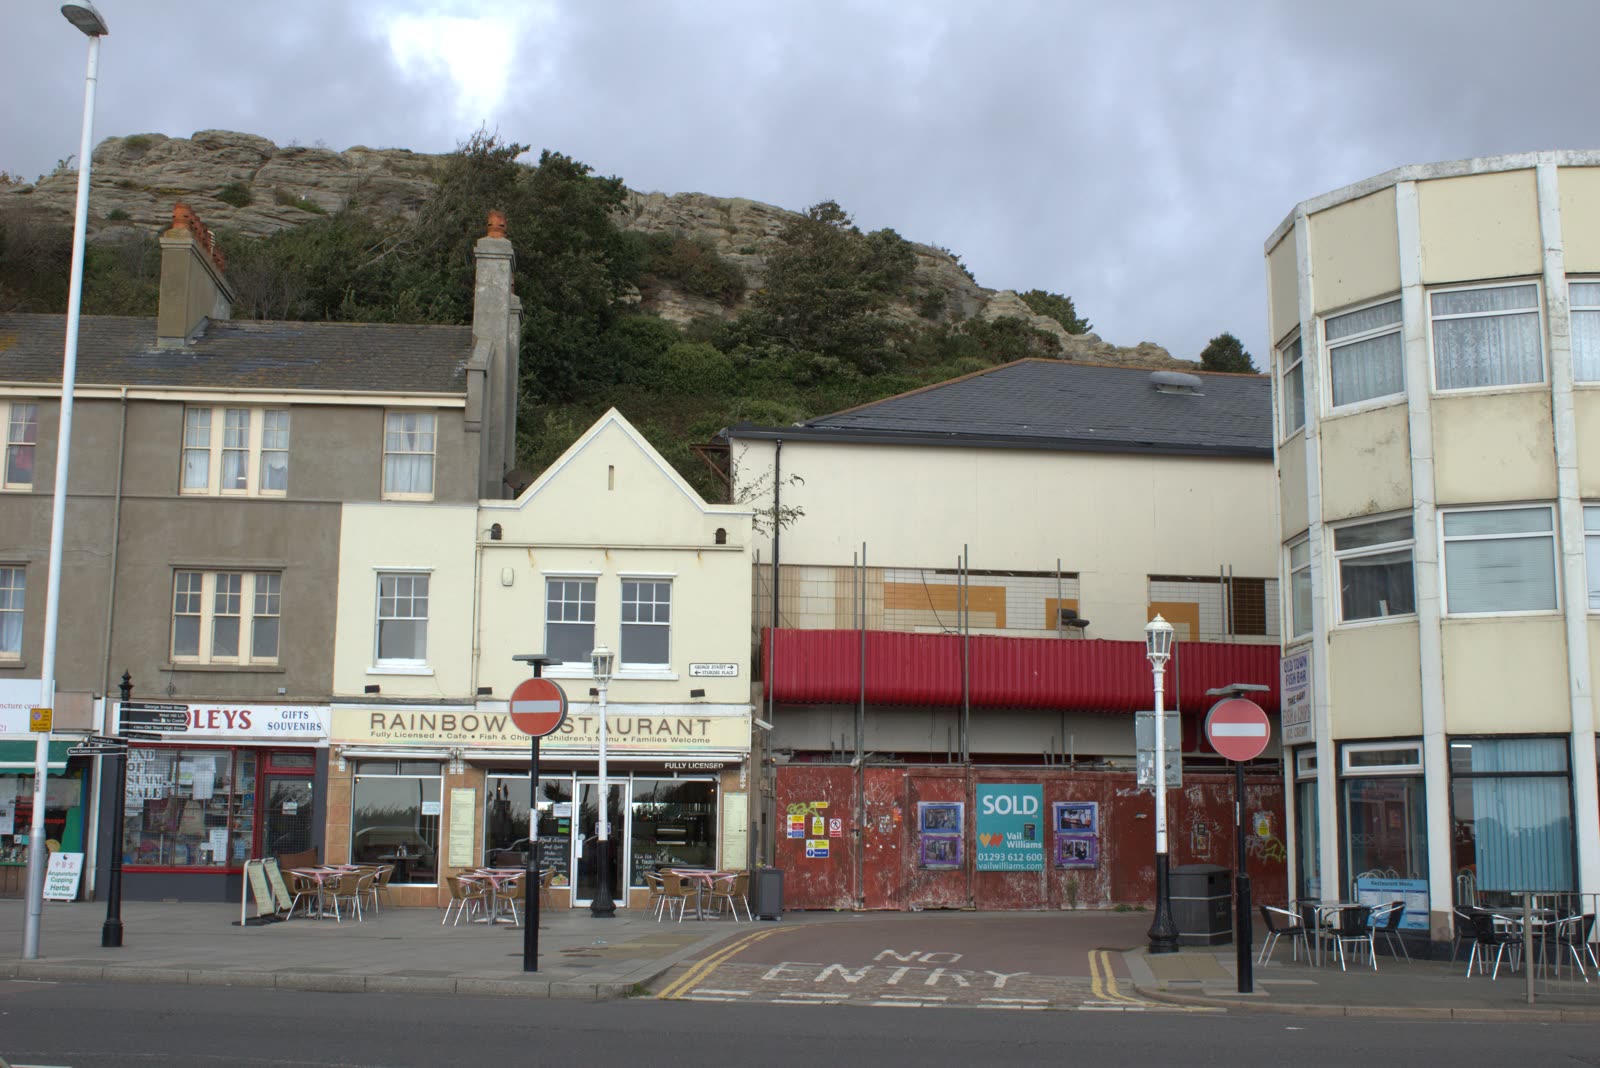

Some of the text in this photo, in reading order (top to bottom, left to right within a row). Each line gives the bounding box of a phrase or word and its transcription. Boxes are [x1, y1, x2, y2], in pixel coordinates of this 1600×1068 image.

[1284, 656, 1308, 673] OLD TOWN
[1286, 669, 1306, 686] FISH BAR
[282, 710, 309, 720] GIFTS
[267, 722, 322, 730] SOUVENIRS
[370, 713, 711, 736] RAINBOW STAURANT
[127, 762, 144, 772] OF
[982, 794, 1038, 815] SOLD
[1006, 832, 1022, 840] Vail
[1006, 840, 1042, 848] Williams
[978, 852, 1042, 862] 01293 612 600
[978, 862, 1042, 870] vailwilliams.com
[872, 949, 964, 964] NO
[761, 961, 1031, 988] ENTRY
